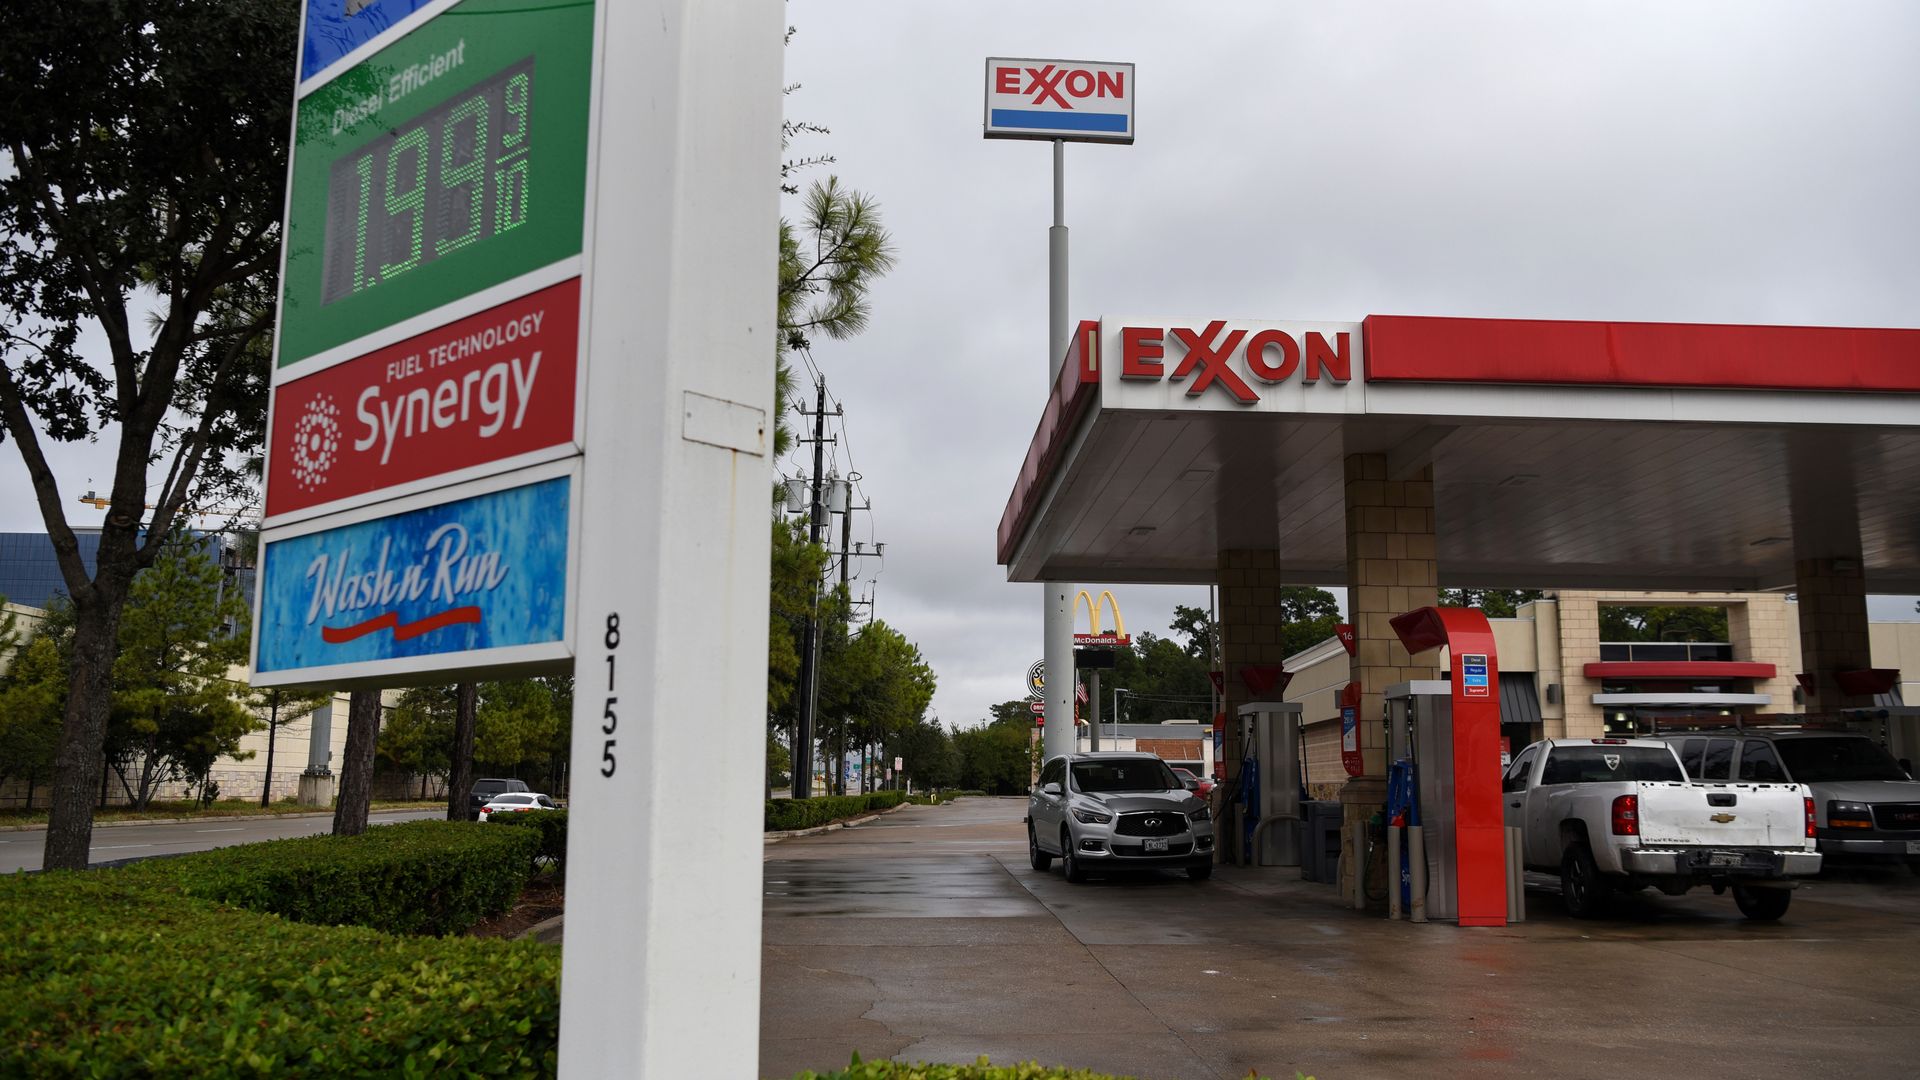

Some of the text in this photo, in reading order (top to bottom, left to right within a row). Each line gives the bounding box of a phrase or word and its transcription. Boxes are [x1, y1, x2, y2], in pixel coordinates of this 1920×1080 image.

[388, 38, 466, 104] Efficient
[995, 64, 1124, 109] EXXON
[503, 72, 529, 148] 9
[353, 95, 489, 293] 1.99
[386, 310, 545, 384] FUEL TECHNOLOGY
[1120, 320, 1352, 405] EXXON
[353, 350, 543, 466] Synergy
[305, 535, 401, 625] Wash
[425, 522, 511, 605] Run
[1342, 632, 1353, 641] 16
